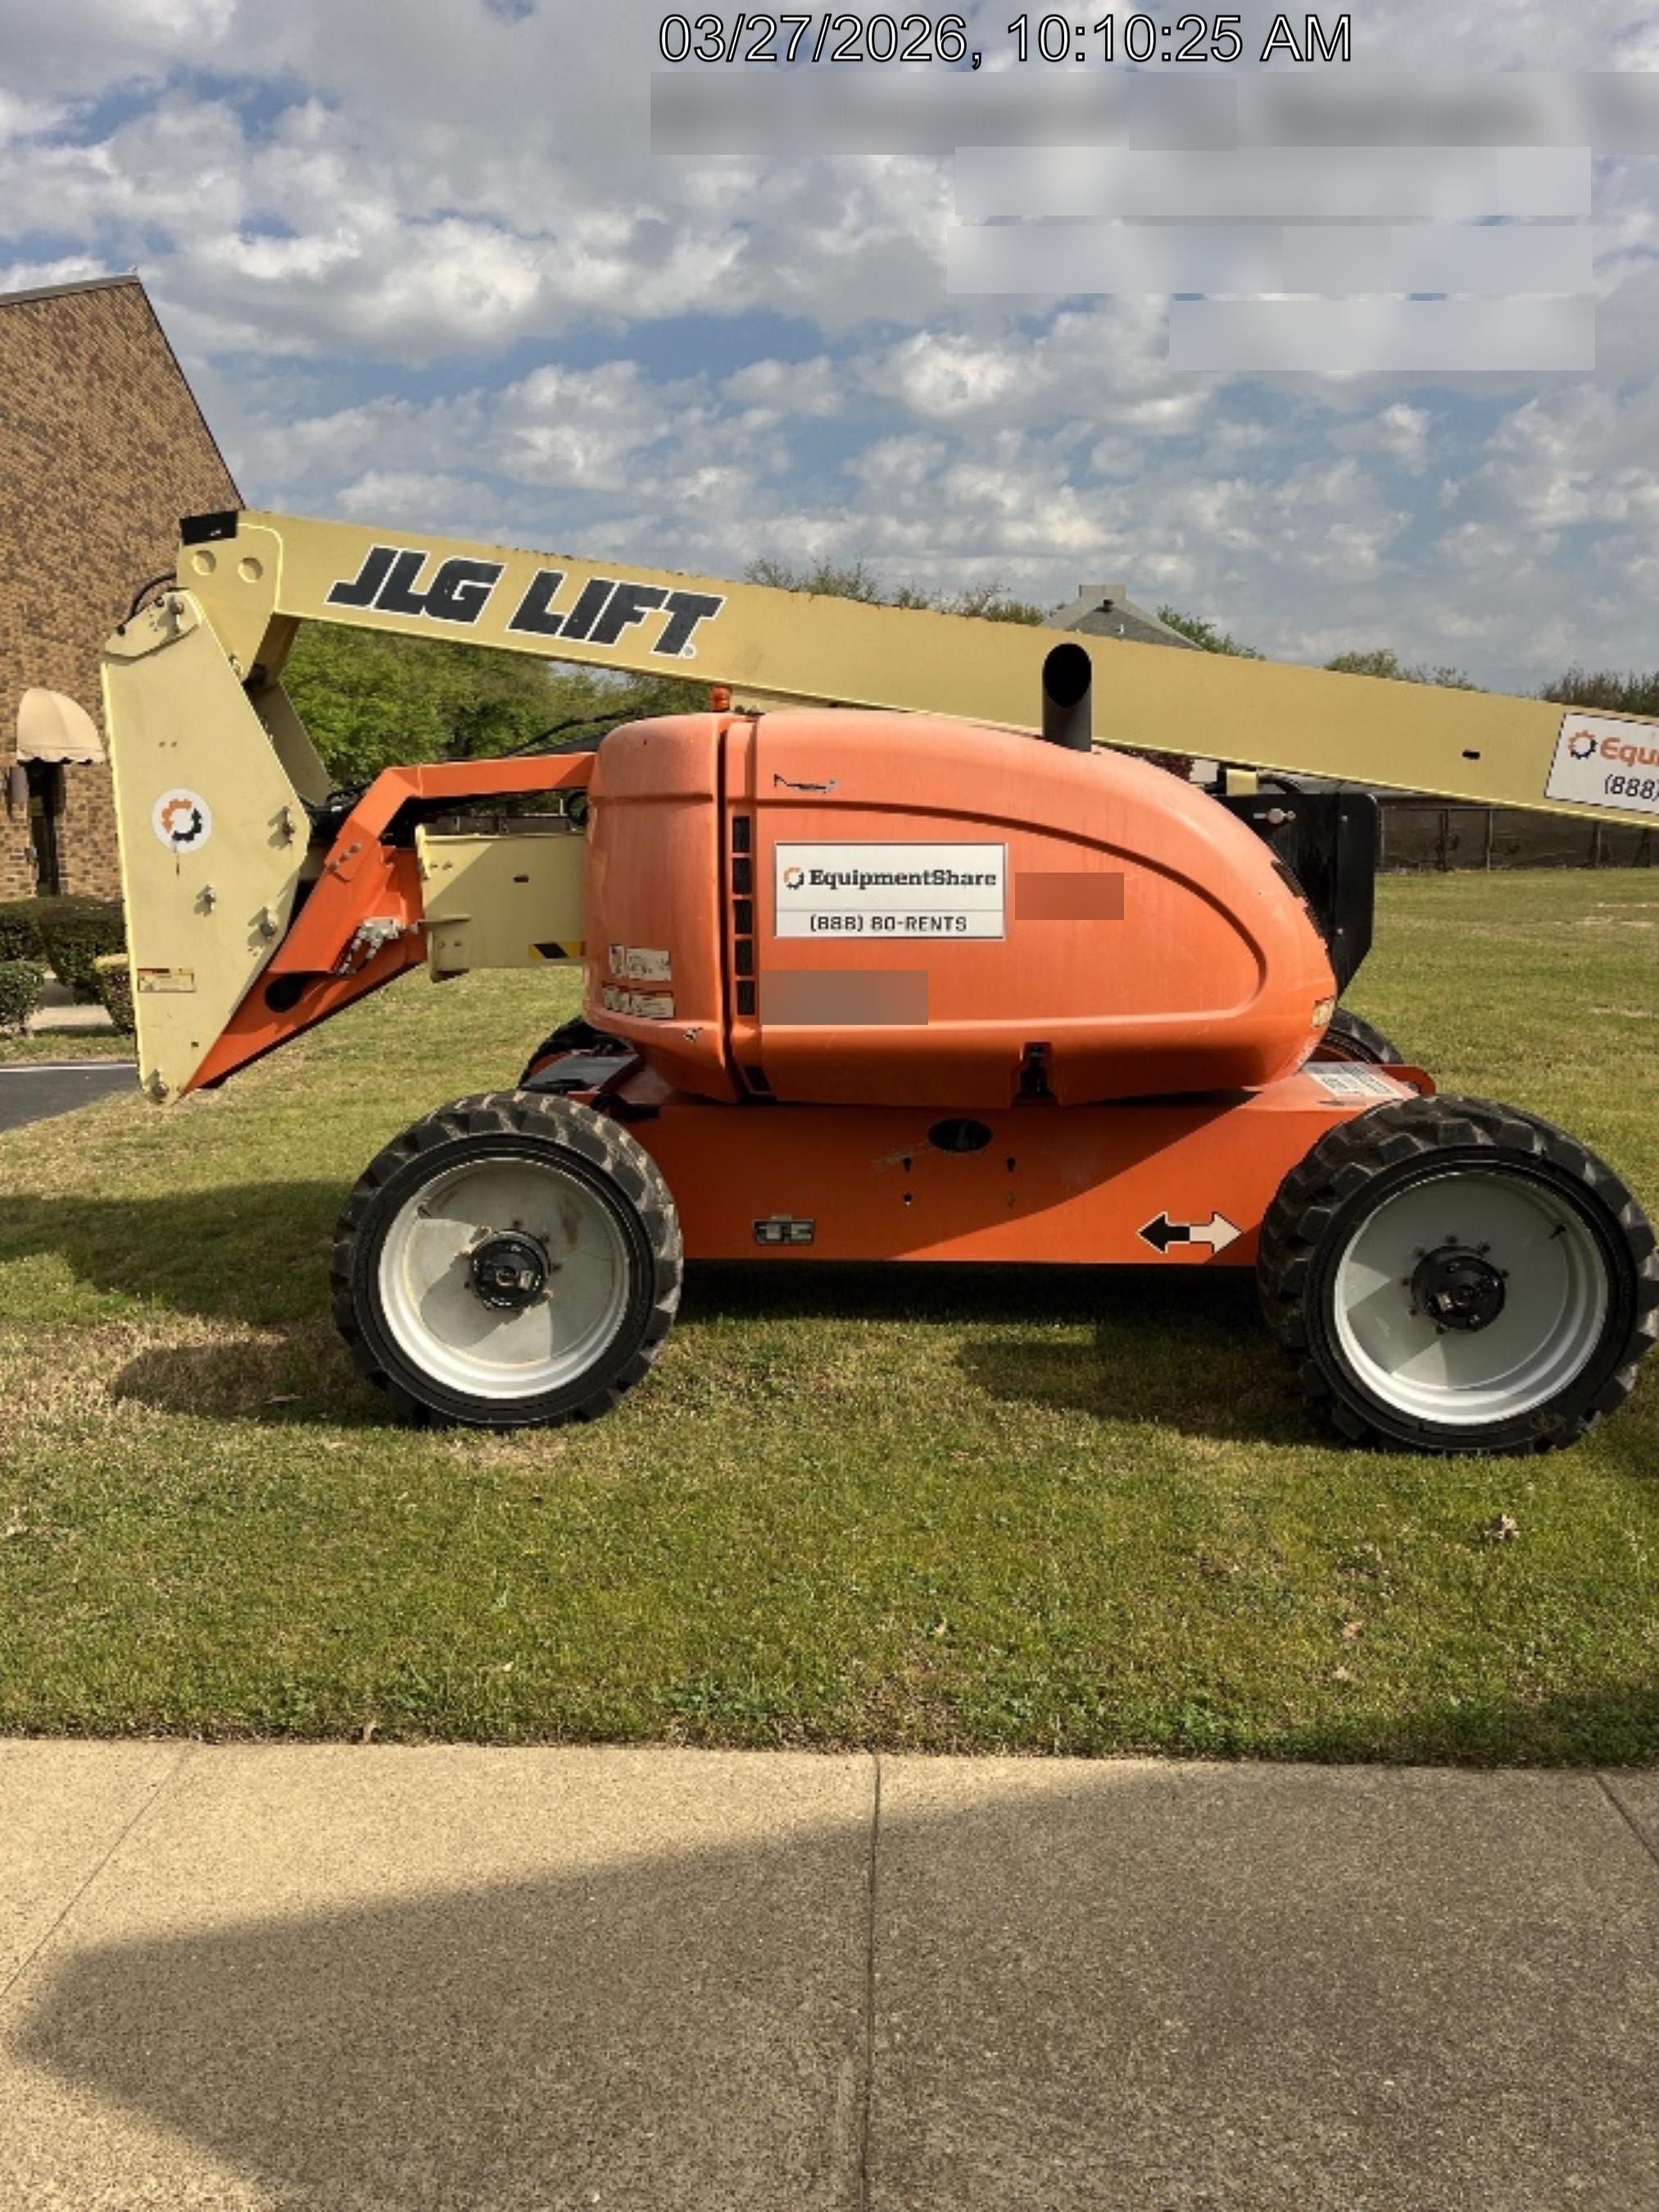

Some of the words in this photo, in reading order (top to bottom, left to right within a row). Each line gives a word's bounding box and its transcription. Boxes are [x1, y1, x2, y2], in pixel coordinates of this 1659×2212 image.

[325, 544, 505, 625] JLG
[505, 568, 727, 658] LIFT
[809, 869, 996, 890] EquipmentShare
[809, 915, 863, 932] (888)
